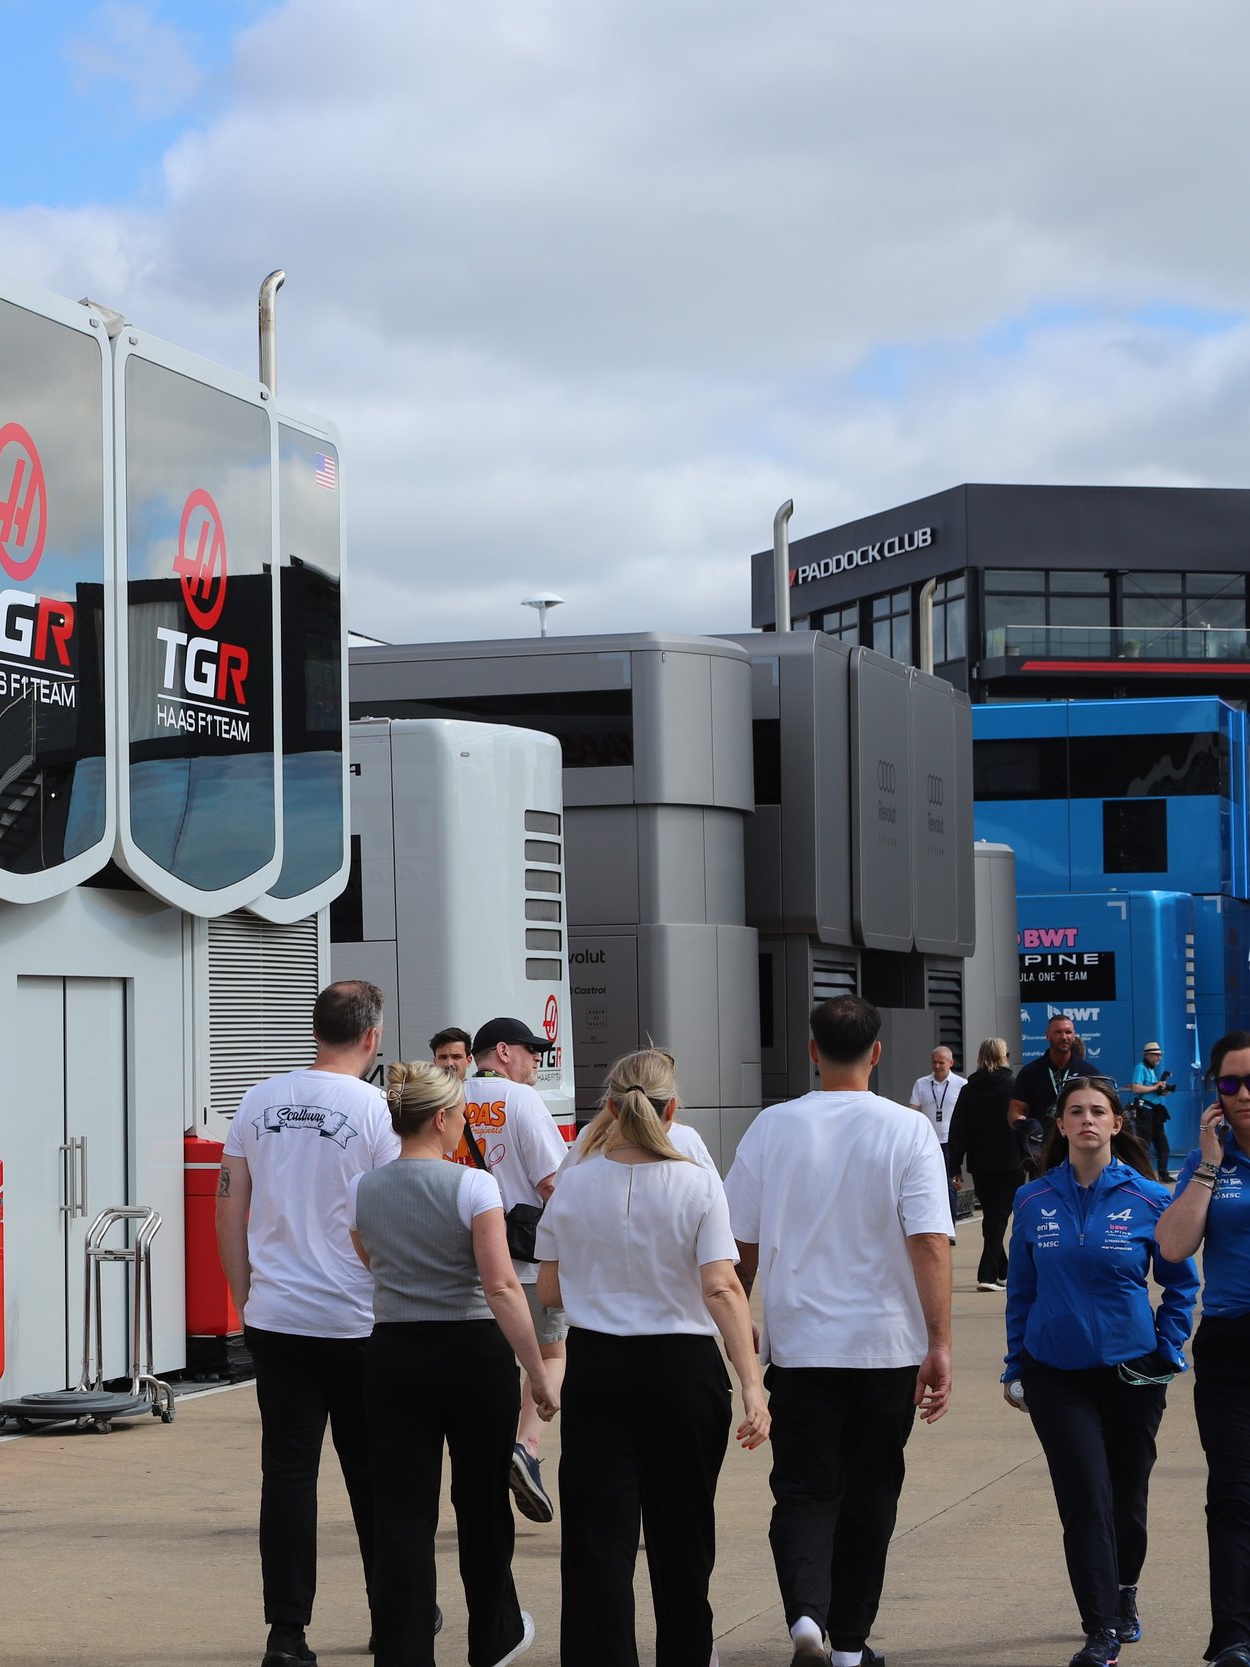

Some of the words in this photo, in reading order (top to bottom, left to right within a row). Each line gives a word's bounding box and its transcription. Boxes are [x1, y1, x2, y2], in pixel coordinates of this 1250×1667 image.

[798, 542, 882, 585] PADDOCK
[883, 527, 932, 558] CLUB
[156, 626, 249, 705] TGR
[30, 677, 76, 708] TEAM
[157, 704, 196, 732] HAAS
[214, 715, 250, 743] TEAM
[1024, 928, 1078, 948] BWT
[569, 949, 606, 964] volut
[1024, 953, 1099, 967] PINE
[1064, 971, 1088, 981] TEAM
[574, 986, 607, 995] Castrol
[1043, 1240, 1060, 1249] MSC
